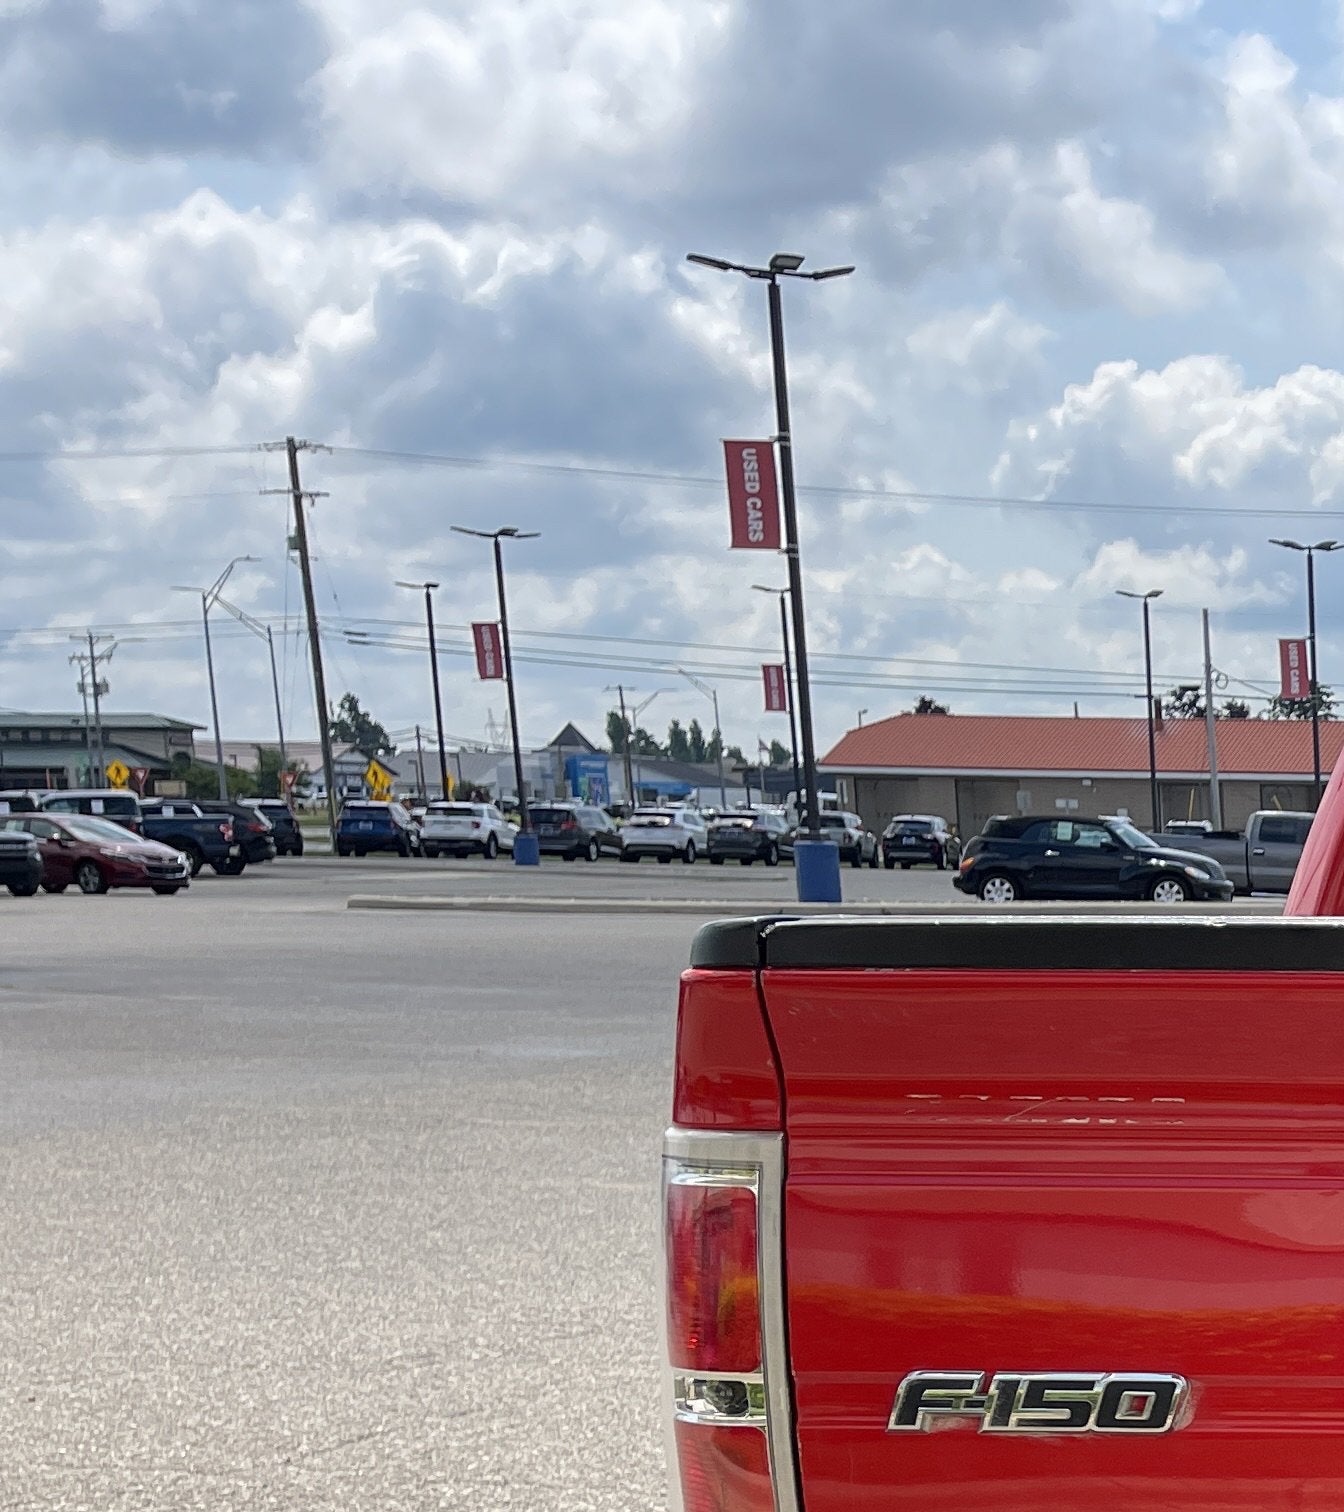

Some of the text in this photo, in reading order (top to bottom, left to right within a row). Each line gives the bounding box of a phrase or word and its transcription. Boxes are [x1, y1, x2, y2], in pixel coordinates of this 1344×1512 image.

[742, 447, 764, 543] USED CARS
[886, 1370, 1190, 1434] F-150
